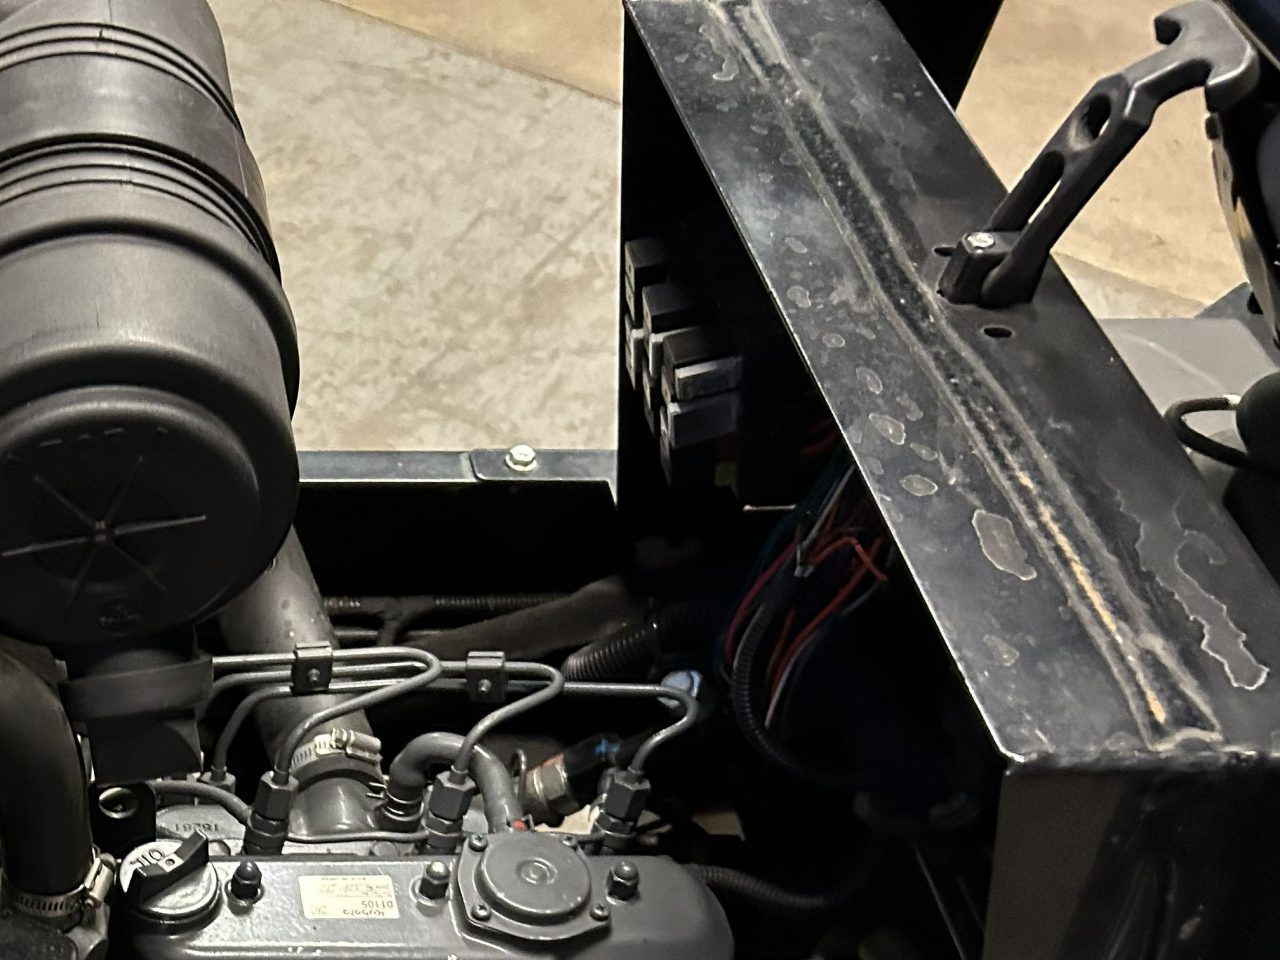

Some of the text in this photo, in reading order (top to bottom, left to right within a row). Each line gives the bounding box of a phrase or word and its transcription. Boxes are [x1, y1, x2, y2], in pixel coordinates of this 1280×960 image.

[129, 849, 166, 868] OIL
[361, 900, 394, 909] D1105
[342, 908, 385, 917] Kubota
